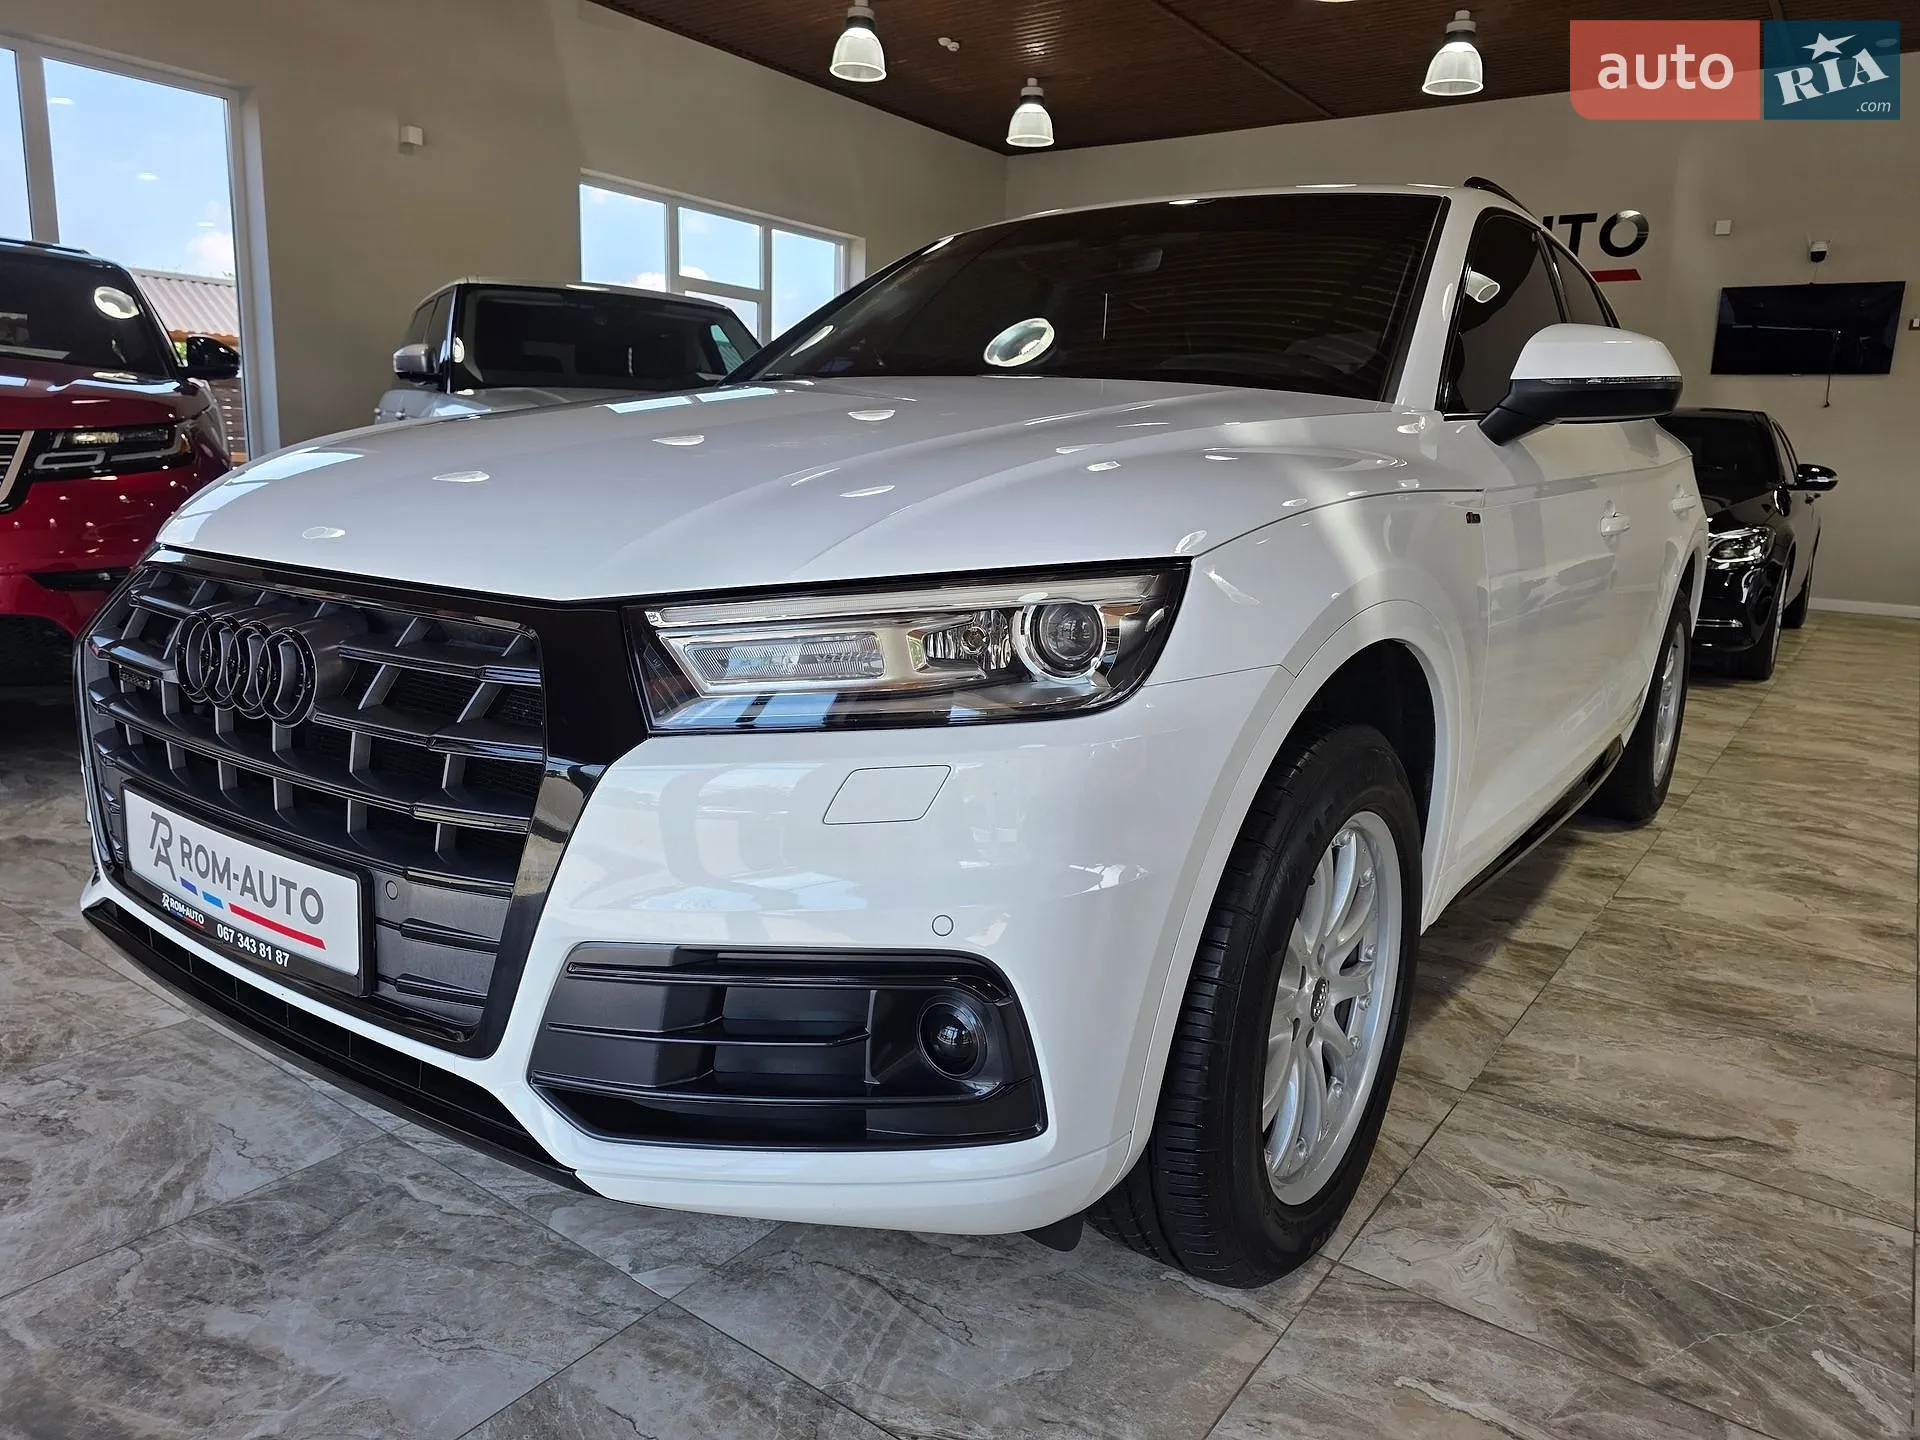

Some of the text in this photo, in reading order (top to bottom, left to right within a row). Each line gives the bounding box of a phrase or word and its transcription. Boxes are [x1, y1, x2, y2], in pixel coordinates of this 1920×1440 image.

[1542, 210, 1649, 257] TO
[180, 835, 324, 924] ROM-AUTO
[170, 899, 204, 924] ROM-AUTO
[217, 924, 290, 967] 067 343 81 87
